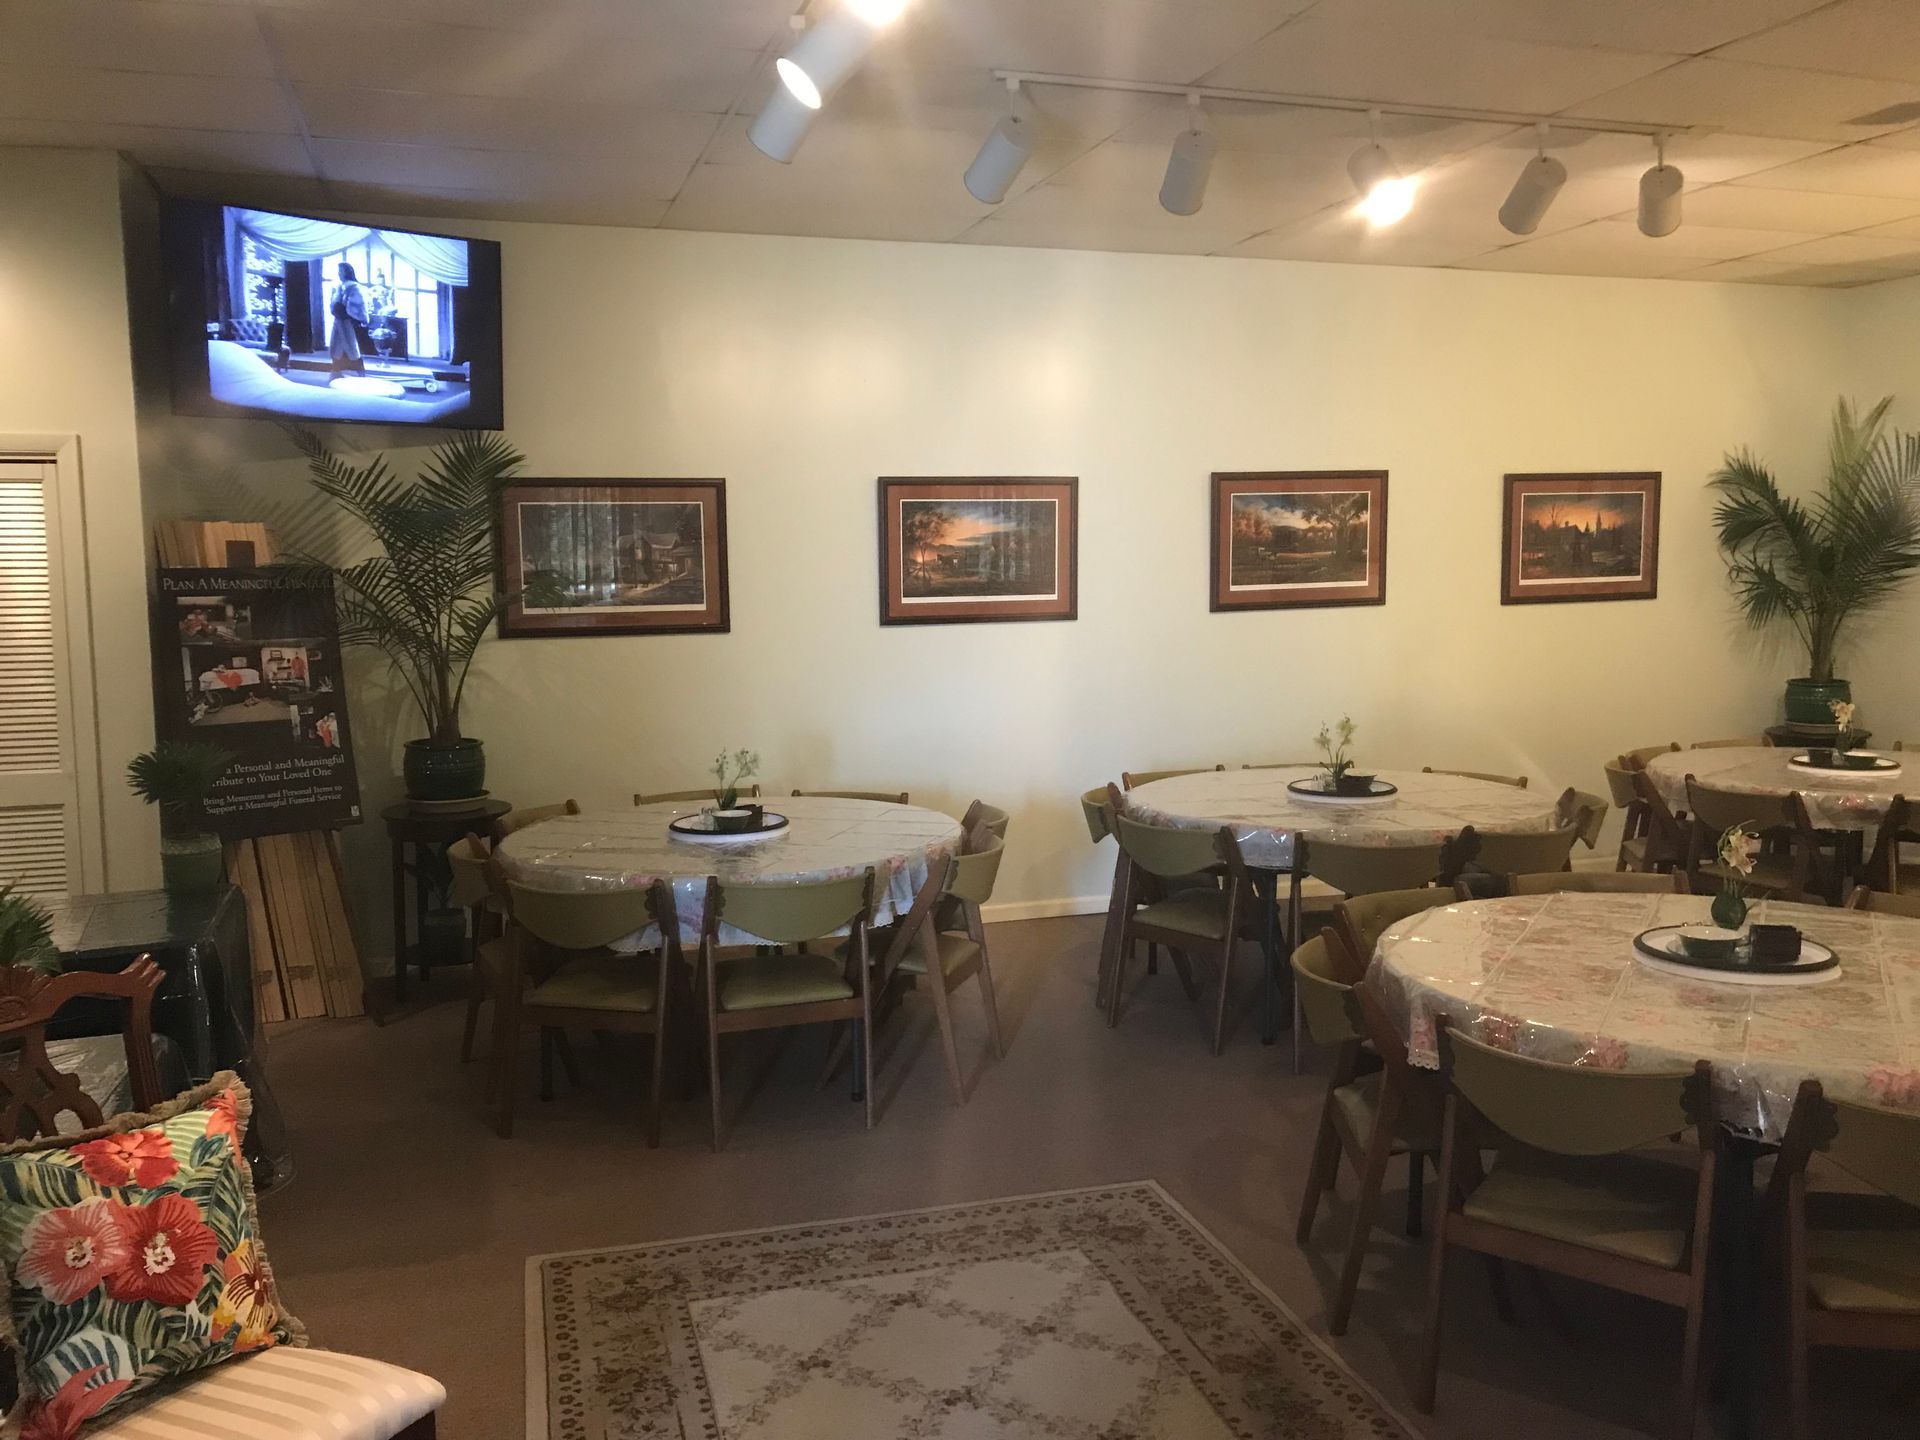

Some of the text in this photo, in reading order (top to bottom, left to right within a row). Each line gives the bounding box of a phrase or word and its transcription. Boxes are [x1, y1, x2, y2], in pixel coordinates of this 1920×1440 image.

[163, 577, 194, 590] PLAN
[198, 577, 208, 590] A
[234, 761, 272, 774] Personal
[275, 760, 291, 770] and
[294, 753, 345, 767] Meaningful
[212, 776, 244, 787] ribute
[258, 773, 281, 783] Your
[283, 768, 310, 780] Loved
[313, 767, 333, 776] One
[203, 797, 225, 806] Bring
[267, 790, 281, 799] and
[283, 787, 312, 797] Personal
[313, 785, 333, 793] Items
[206, 804, 237, 815] Support
[245, 797, 287, 809] Meaningful
[288, 794, 315, 805] Funeral
[317, 793, 342, 802] Service
